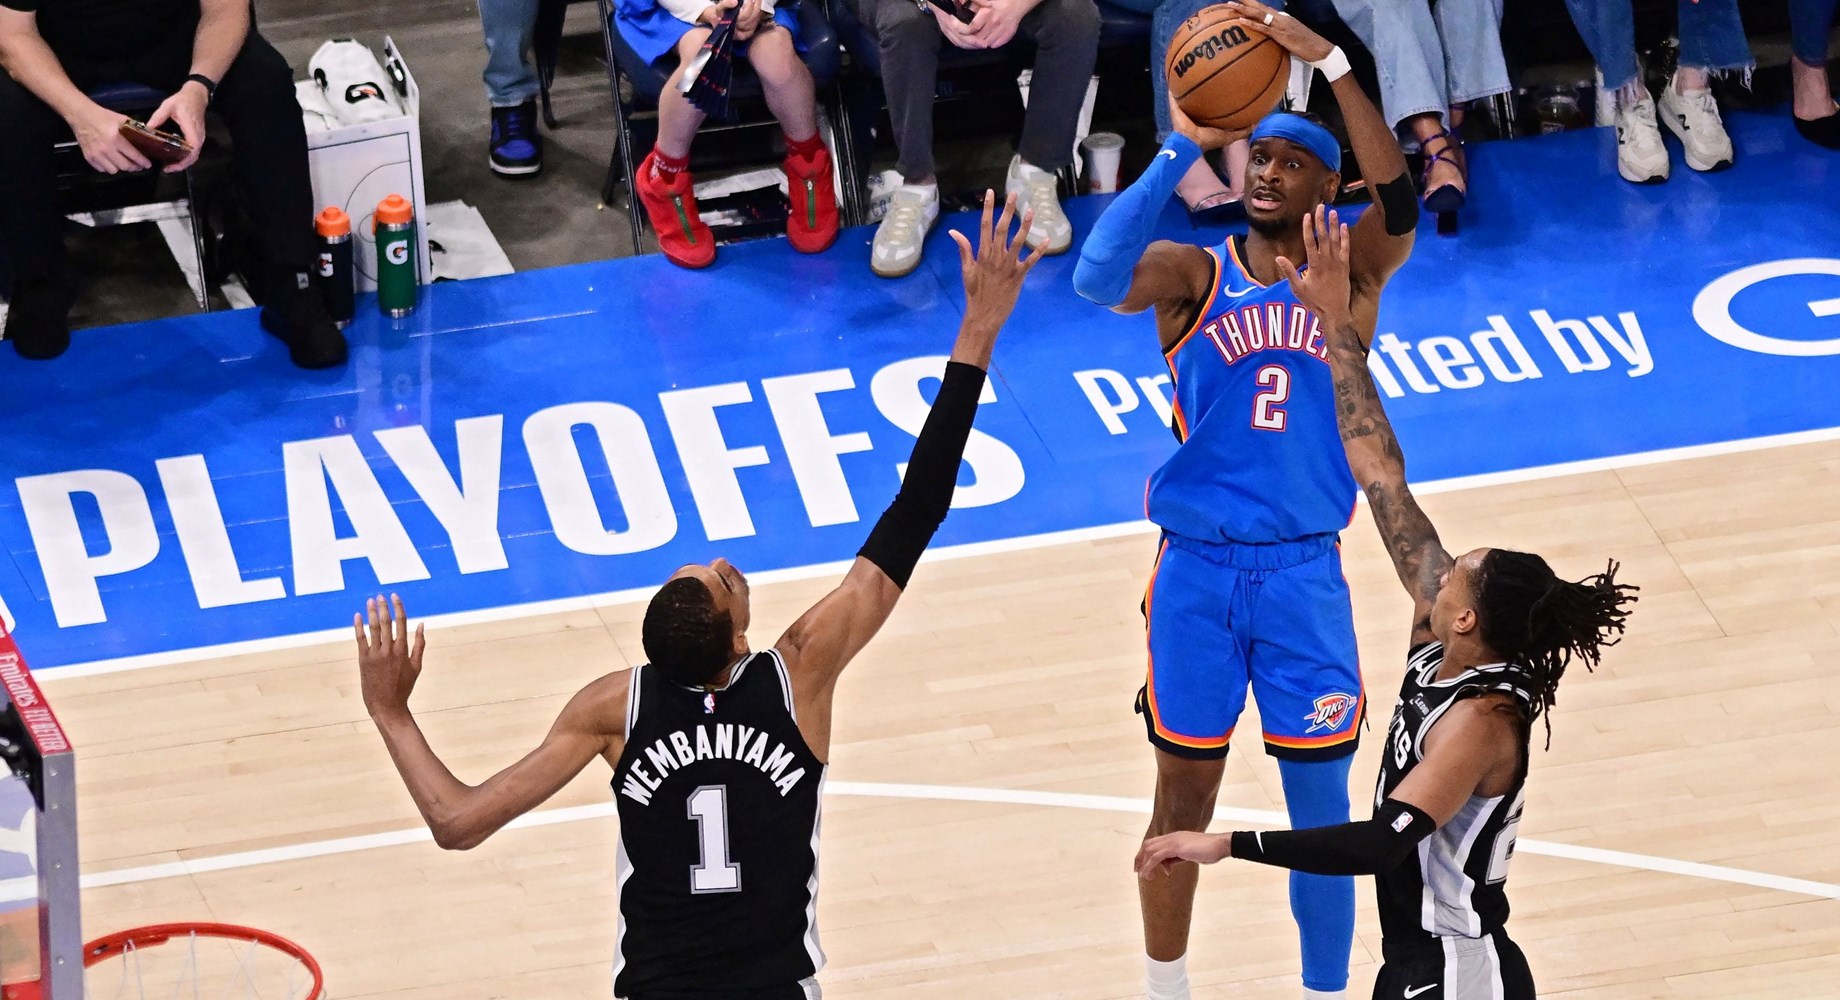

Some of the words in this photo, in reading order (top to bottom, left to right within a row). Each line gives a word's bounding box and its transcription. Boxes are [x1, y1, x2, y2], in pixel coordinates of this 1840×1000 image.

[1173, 25, 1251, 78] Wilson
[385, 239, 409, 265] G
[1529, 309, 1655, 378] by
[1251, 364, 1291, 432] 2
[15, 355, 1027, 629] PLAYOFFS
[0, 652, 38, 708] Emirates
[1316, 701, 1344, 724] OKC
[621, 723, 806, 807] WEMBANYAMA
[686, 784, 742, 895] 1
